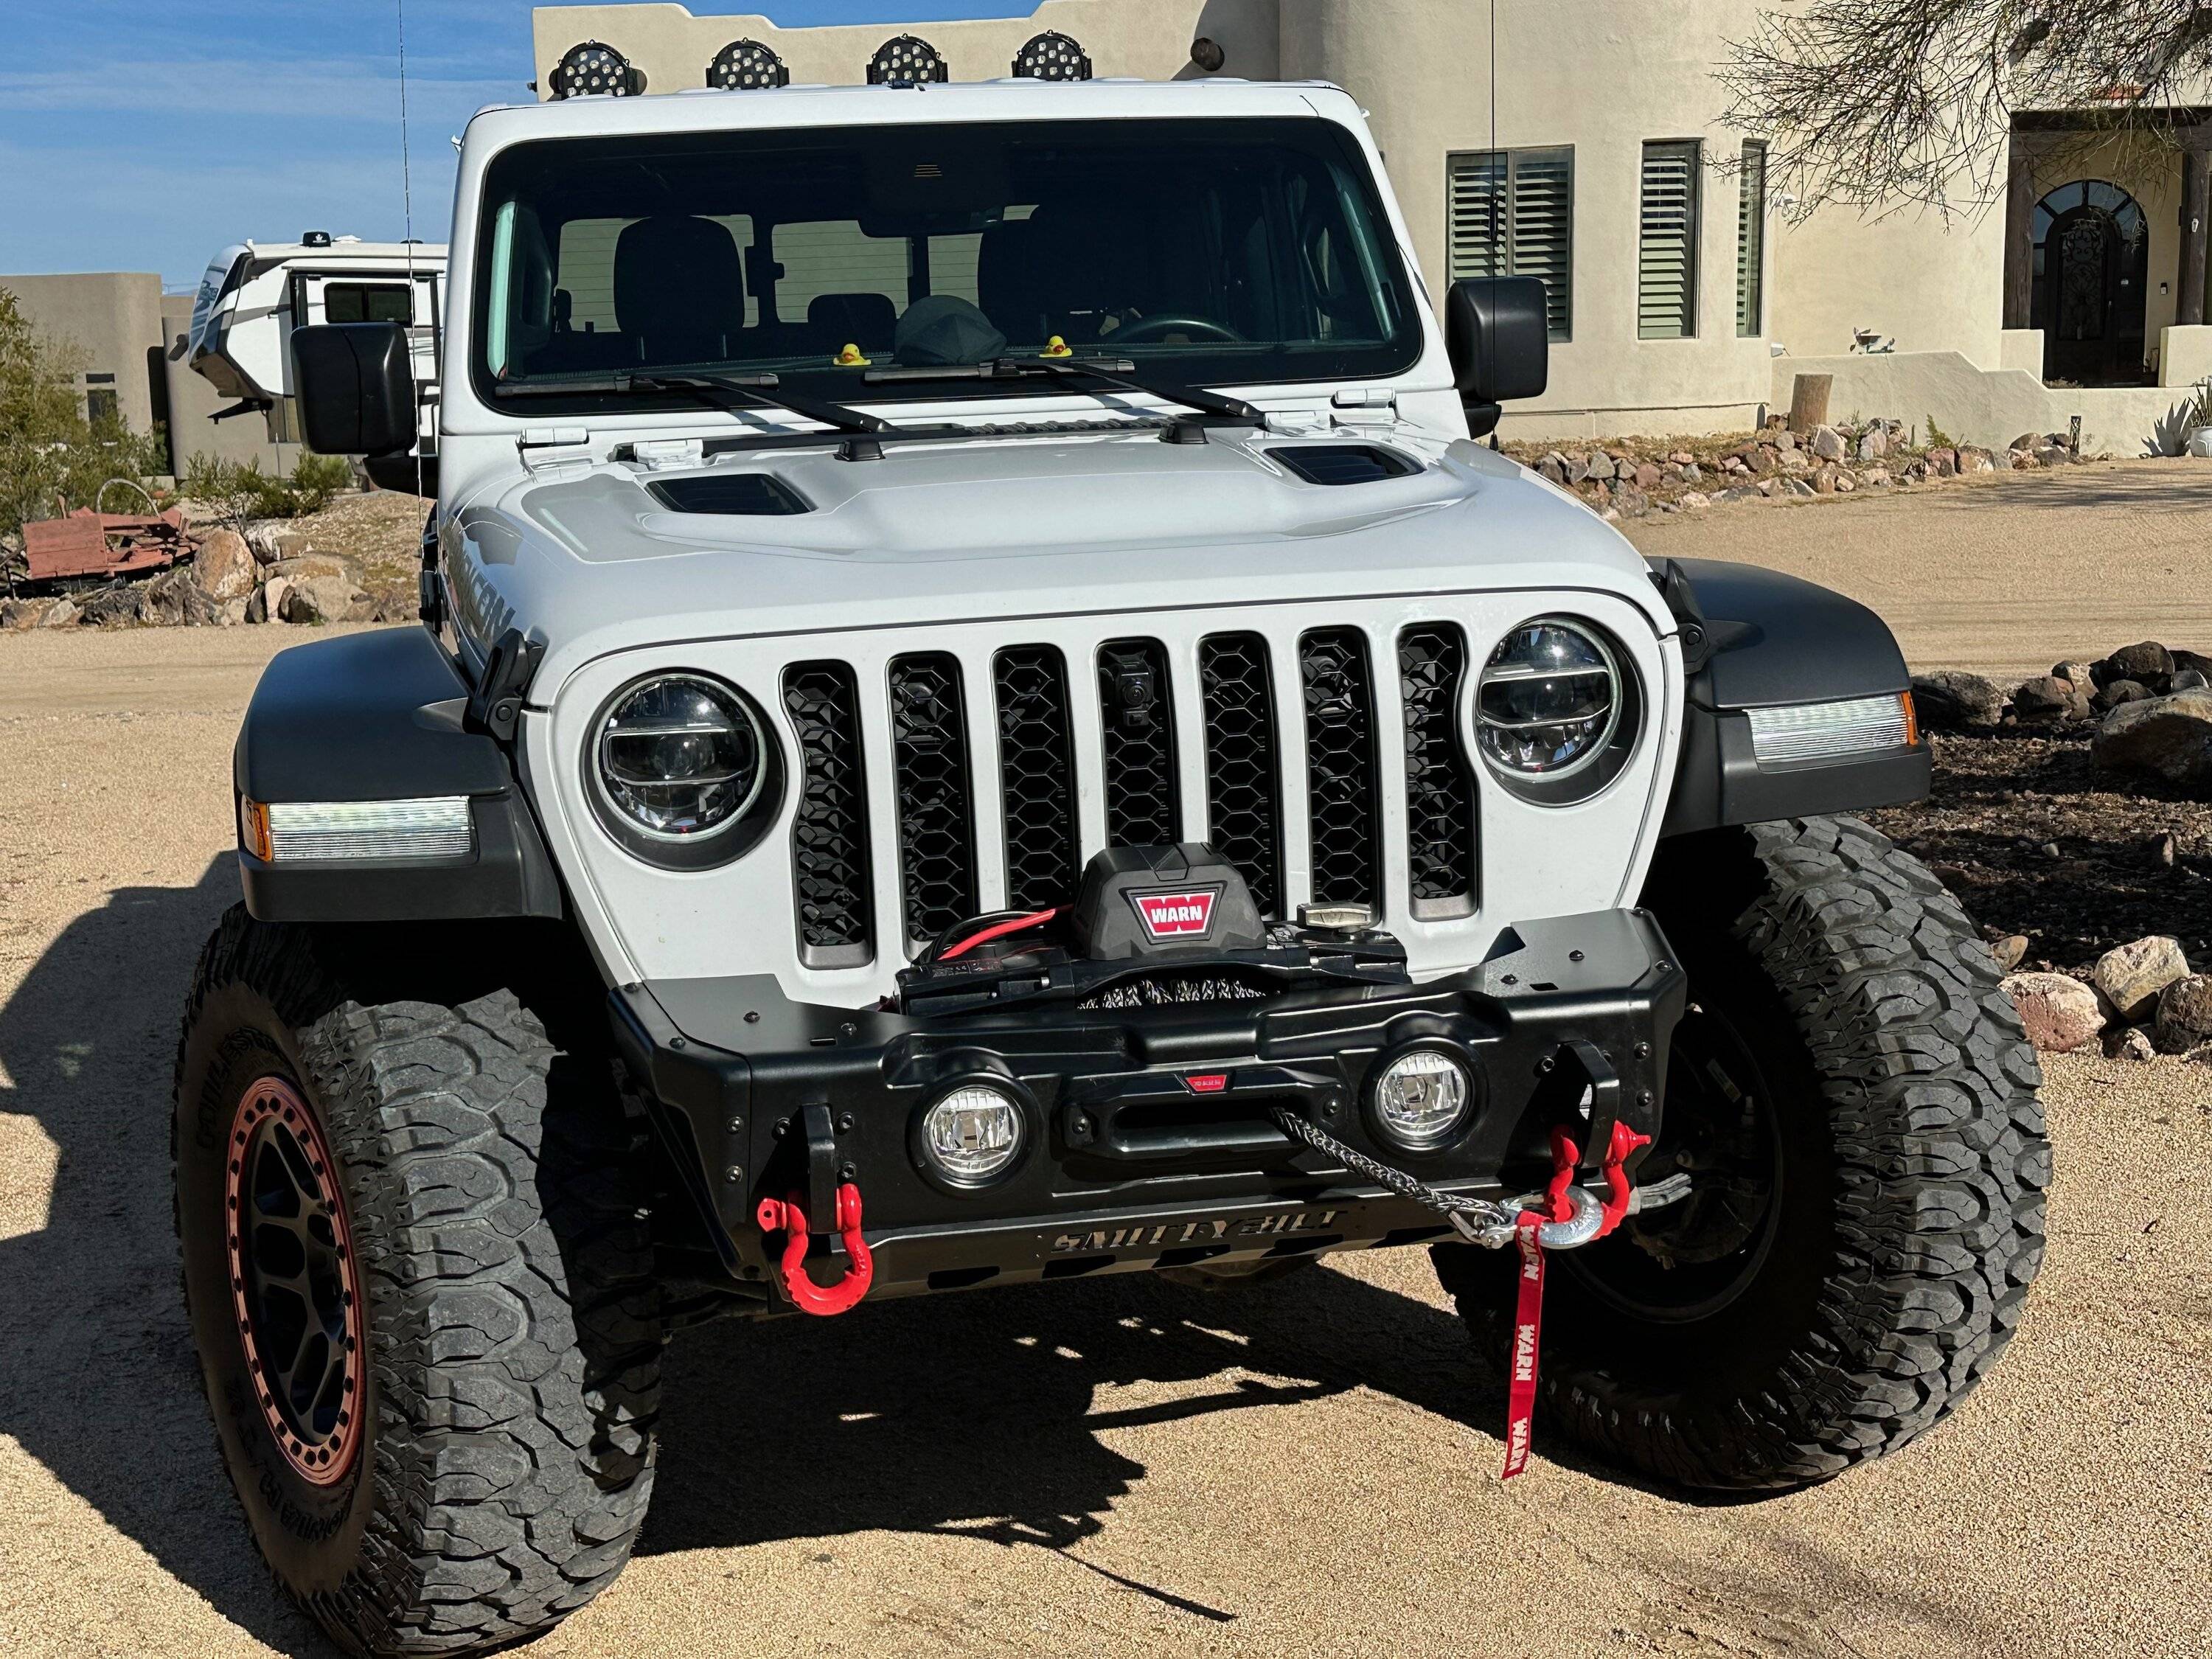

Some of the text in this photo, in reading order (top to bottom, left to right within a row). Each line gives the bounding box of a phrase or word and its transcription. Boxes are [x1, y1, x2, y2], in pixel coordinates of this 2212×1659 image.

[1150, 905, 1203, 924] WARN
[1051, 1210, 1348, 1253] SMITTYBILT
[1520, 1225, 1540, 1281] WARN
[1515, 1324, 1535, 1381] WARN
[1507, 1417, 1528, 1472] WARN
